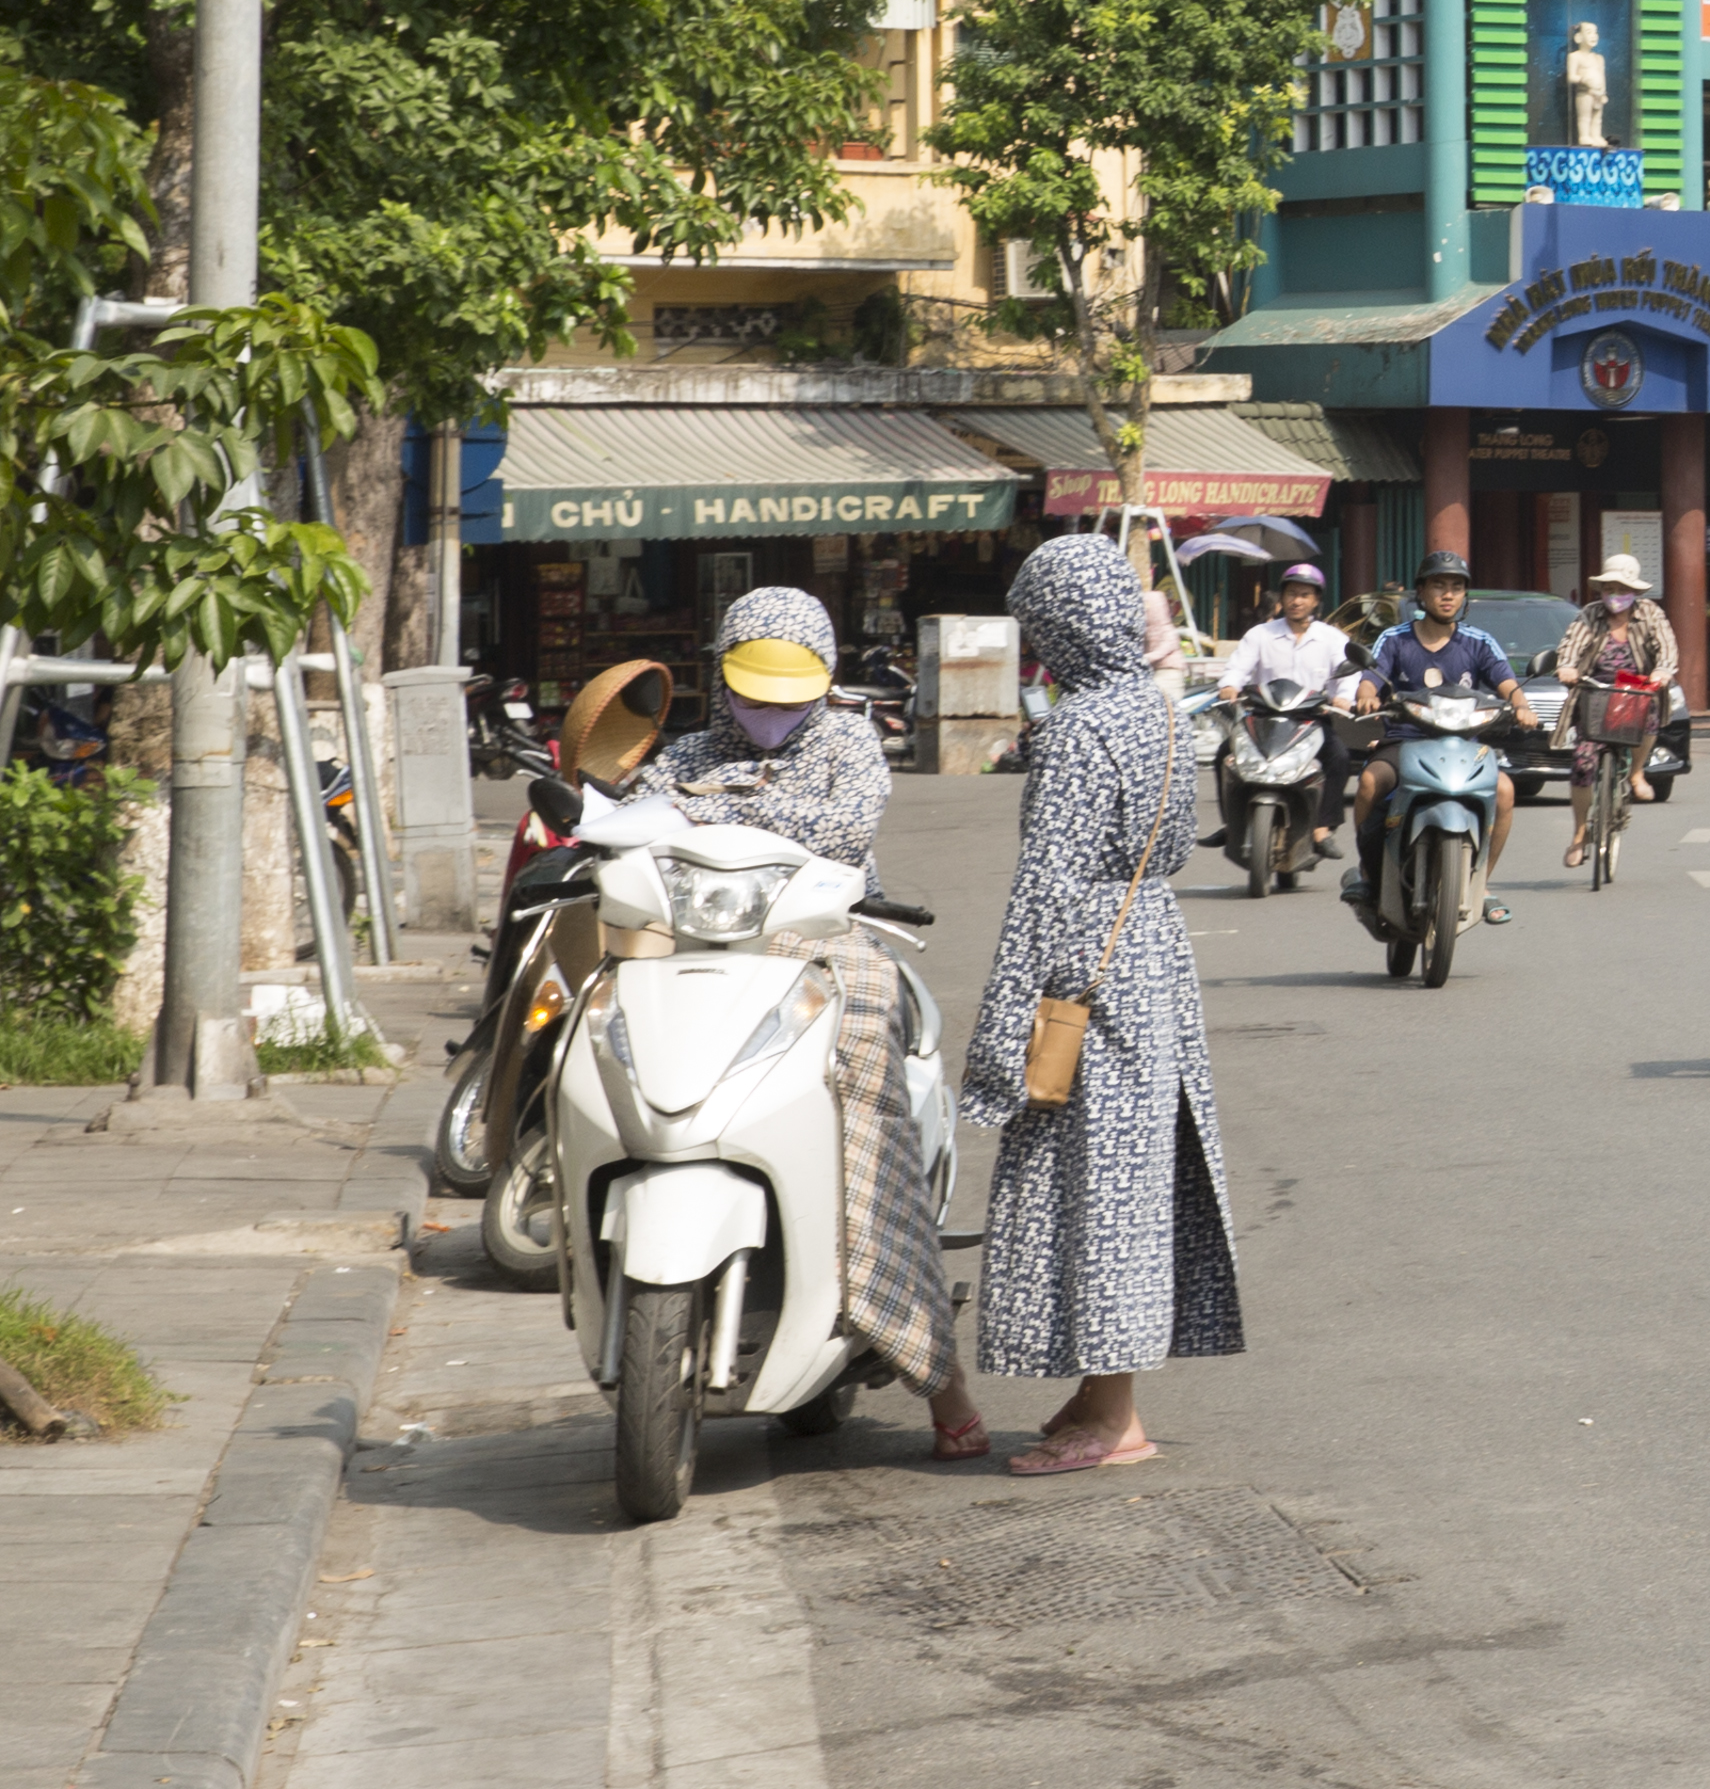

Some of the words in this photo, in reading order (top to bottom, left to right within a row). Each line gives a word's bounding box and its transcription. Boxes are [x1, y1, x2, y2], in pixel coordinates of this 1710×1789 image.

[1050, 473, 1093, 500] Shop
[1159, 481, 1203, 504] LONG
[1205, 482, 1321, 505] HANDICRAFTS
[550, 489, 644, 529] CHỦ
[694, 493, 985, 524] HANDICRAFT
